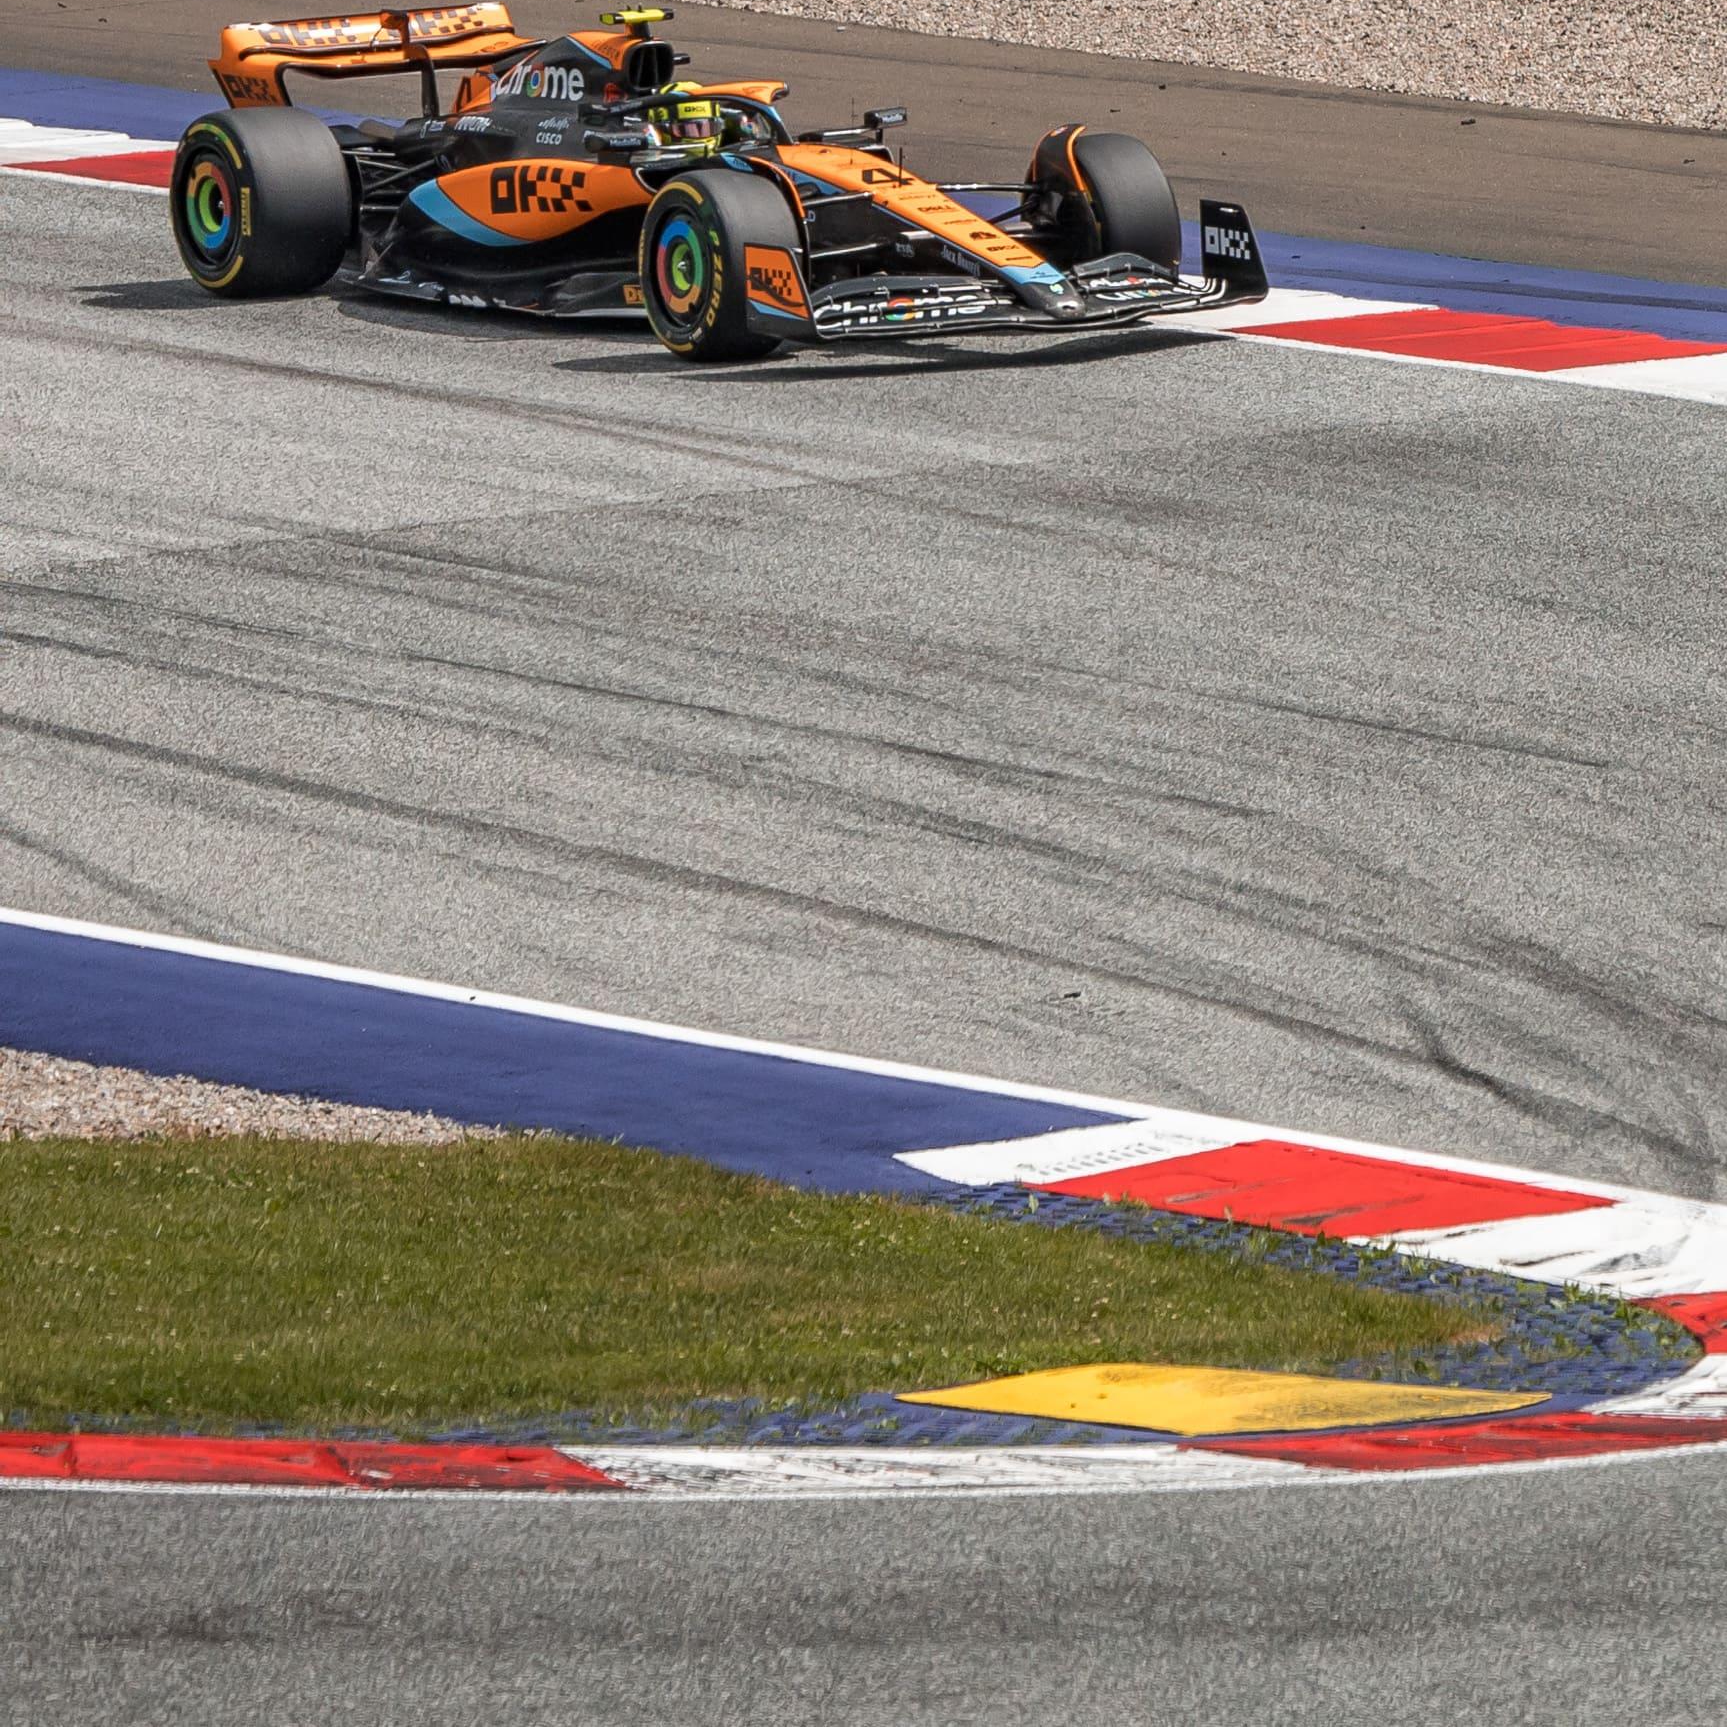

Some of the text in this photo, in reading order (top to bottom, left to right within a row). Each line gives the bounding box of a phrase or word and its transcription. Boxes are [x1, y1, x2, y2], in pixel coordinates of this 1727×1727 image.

[257, 21, 358, 48] OKX
[220, 75, 277, 105] OKX
[495, 62, 585, 102] chrome
[536, 131, 562, 144] CISCO
[490, 165, 593, 215] OKX
[862, 168, 914, 185] 4
[1204, 226, 1251, 260] OKX
[705, 252, 725, 328] ZERO
[812, 295, 986, 325] chrome
